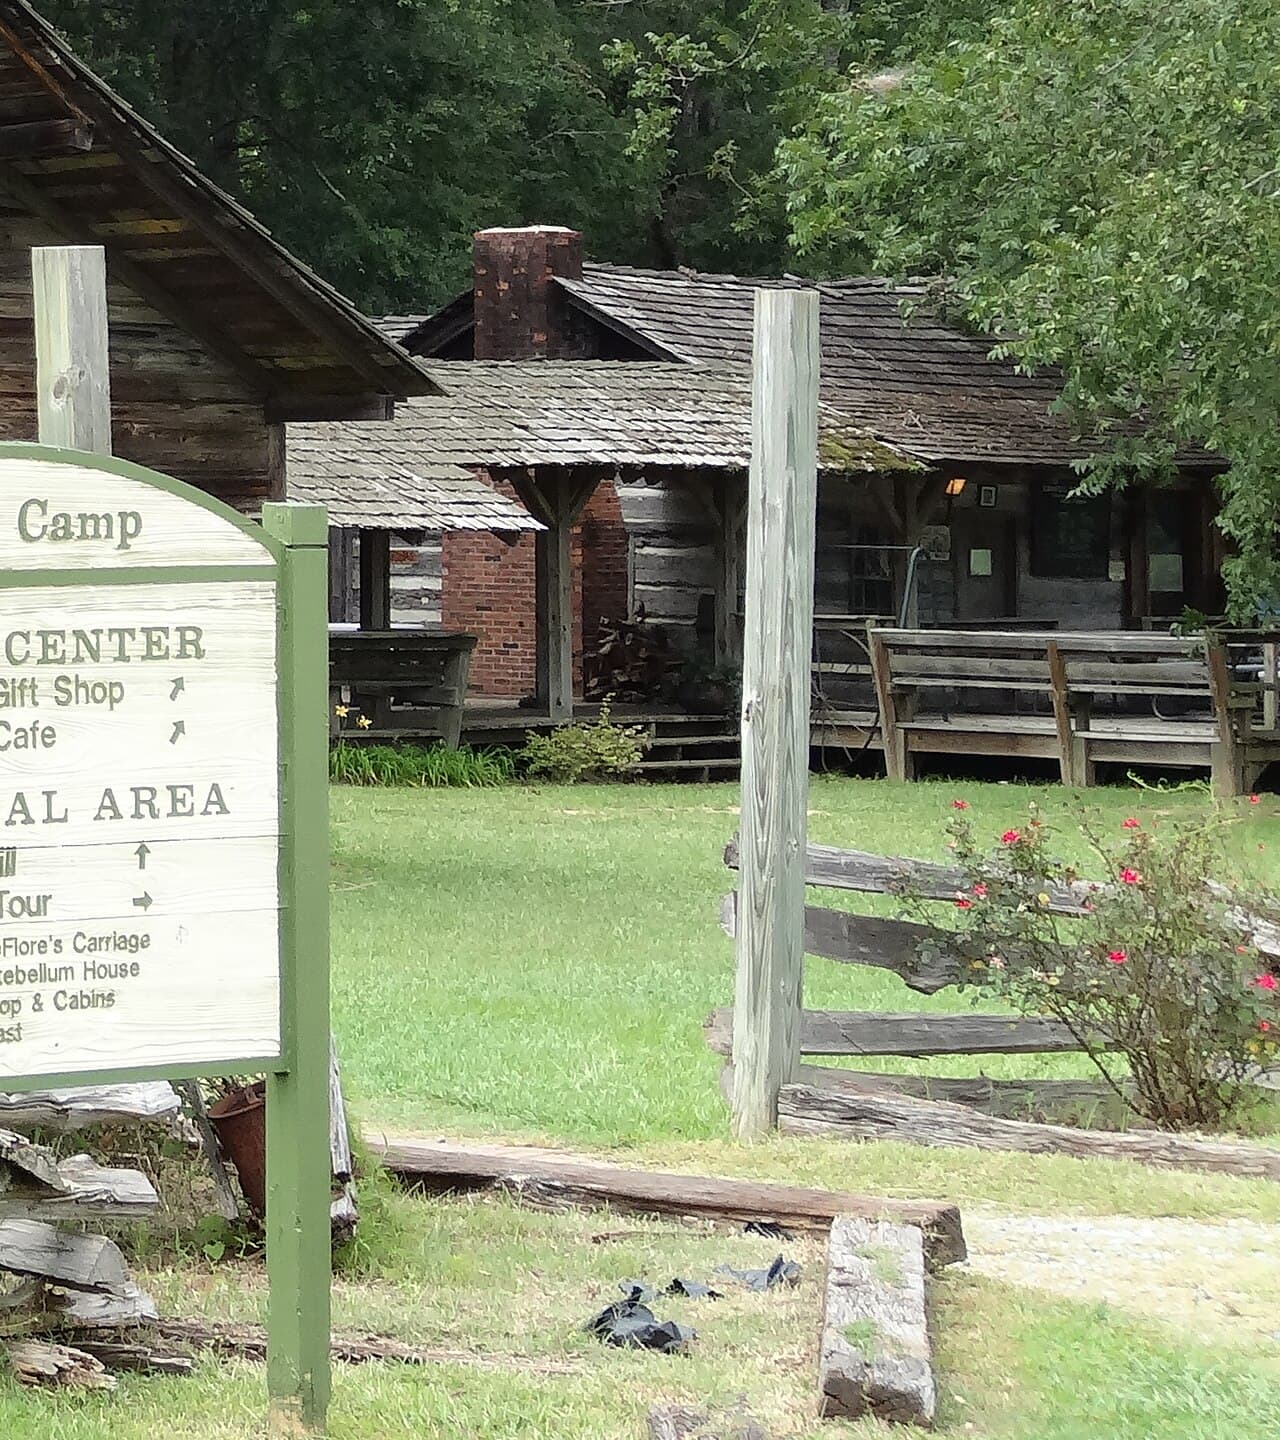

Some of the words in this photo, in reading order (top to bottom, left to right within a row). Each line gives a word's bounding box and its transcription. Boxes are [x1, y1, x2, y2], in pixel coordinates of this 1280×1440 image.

[17, 498, 144, 549] Camp
[5, 625, 207, 666] CENTER
[54, 674, 125, 711] Shop
[93, 782, 232, 822] AREA
[72, 931, 151, 954] Carriage
[83, 960, 141, 981] House
[31, 992, 44, 1012] &
[53, 989, 116, 1011] Cabins
